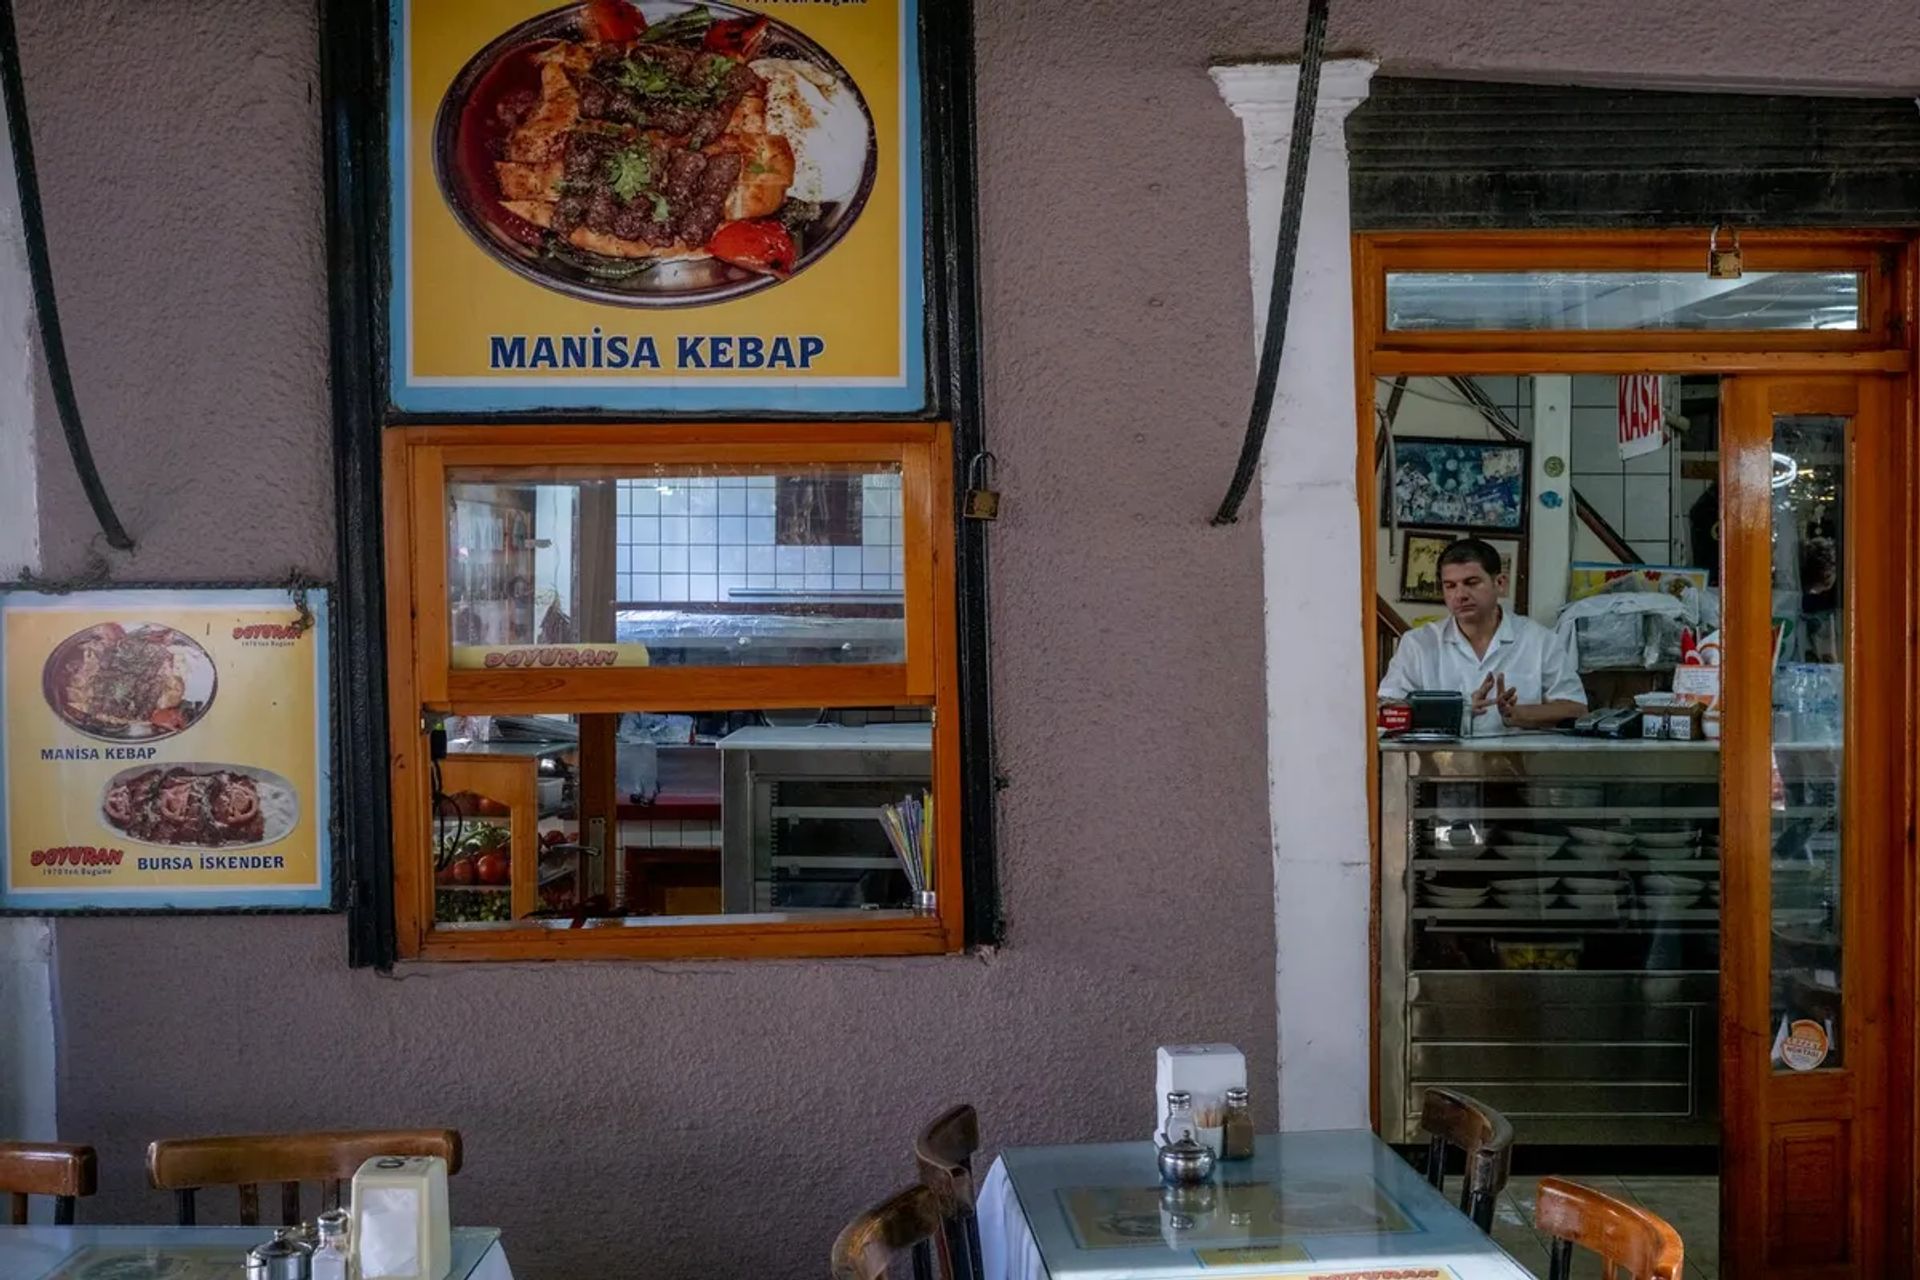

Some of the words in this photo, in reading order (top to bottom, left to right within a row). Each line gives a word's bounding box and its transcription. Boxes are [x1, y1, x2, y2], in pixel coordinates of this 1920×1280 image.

[489, 326, 662, 369] MANİSA
[676, 336, 824, 369] KEBAP
[1619, 375, 1661, 443] KASA
[484, 648, 618, 667] DOYURAN
[40, 745, 100, 761] MANİSA
[104, 747, 157, 760] KEBAP
[30, 846, 124, 866] DOYURAN
[137, 857, 194, 871] BURSA
[200, 853, 285, 870] İSKENDER
